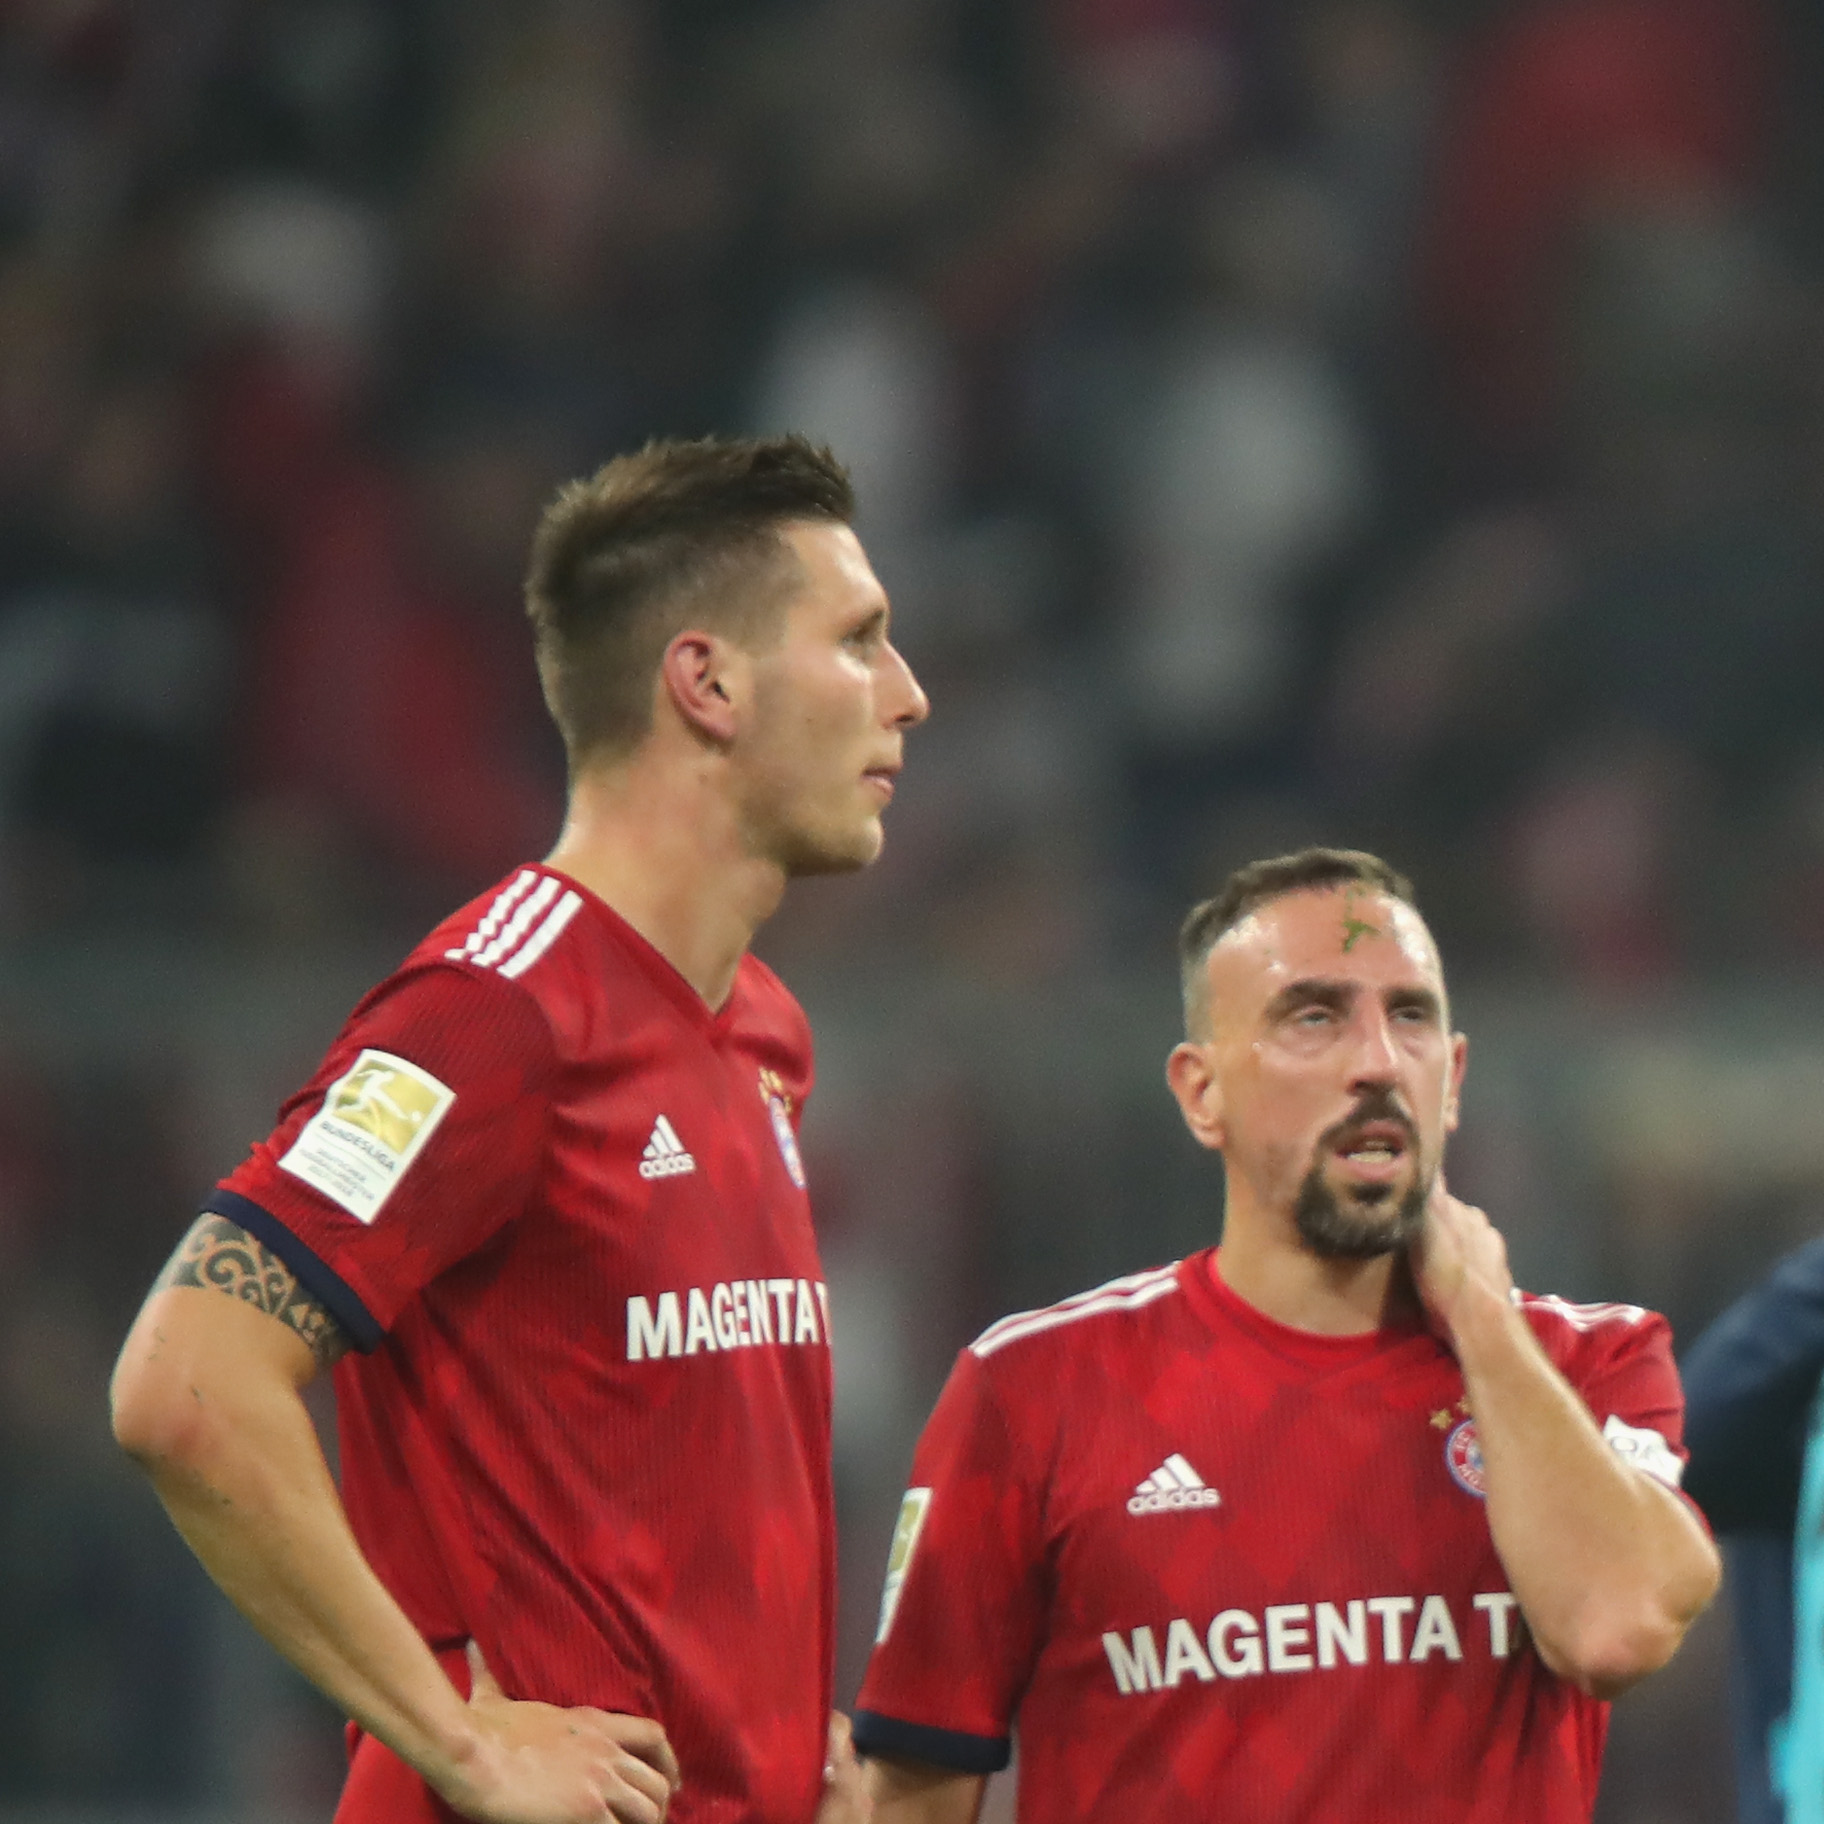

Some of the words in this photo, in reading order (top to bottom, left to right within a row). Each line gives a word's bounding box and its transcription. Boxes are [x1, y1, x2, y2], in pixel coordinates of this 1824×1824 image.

[320, 1121, 396, 1172] BUNDESLIGA
[638, 1152, 696, 1179] adidas
[626, 1279, 820, 1363] MAGENTA
[1125, 1487, 1221, 1516] adidas
[1101, 1594, 1464, 1697] MAGENTA
